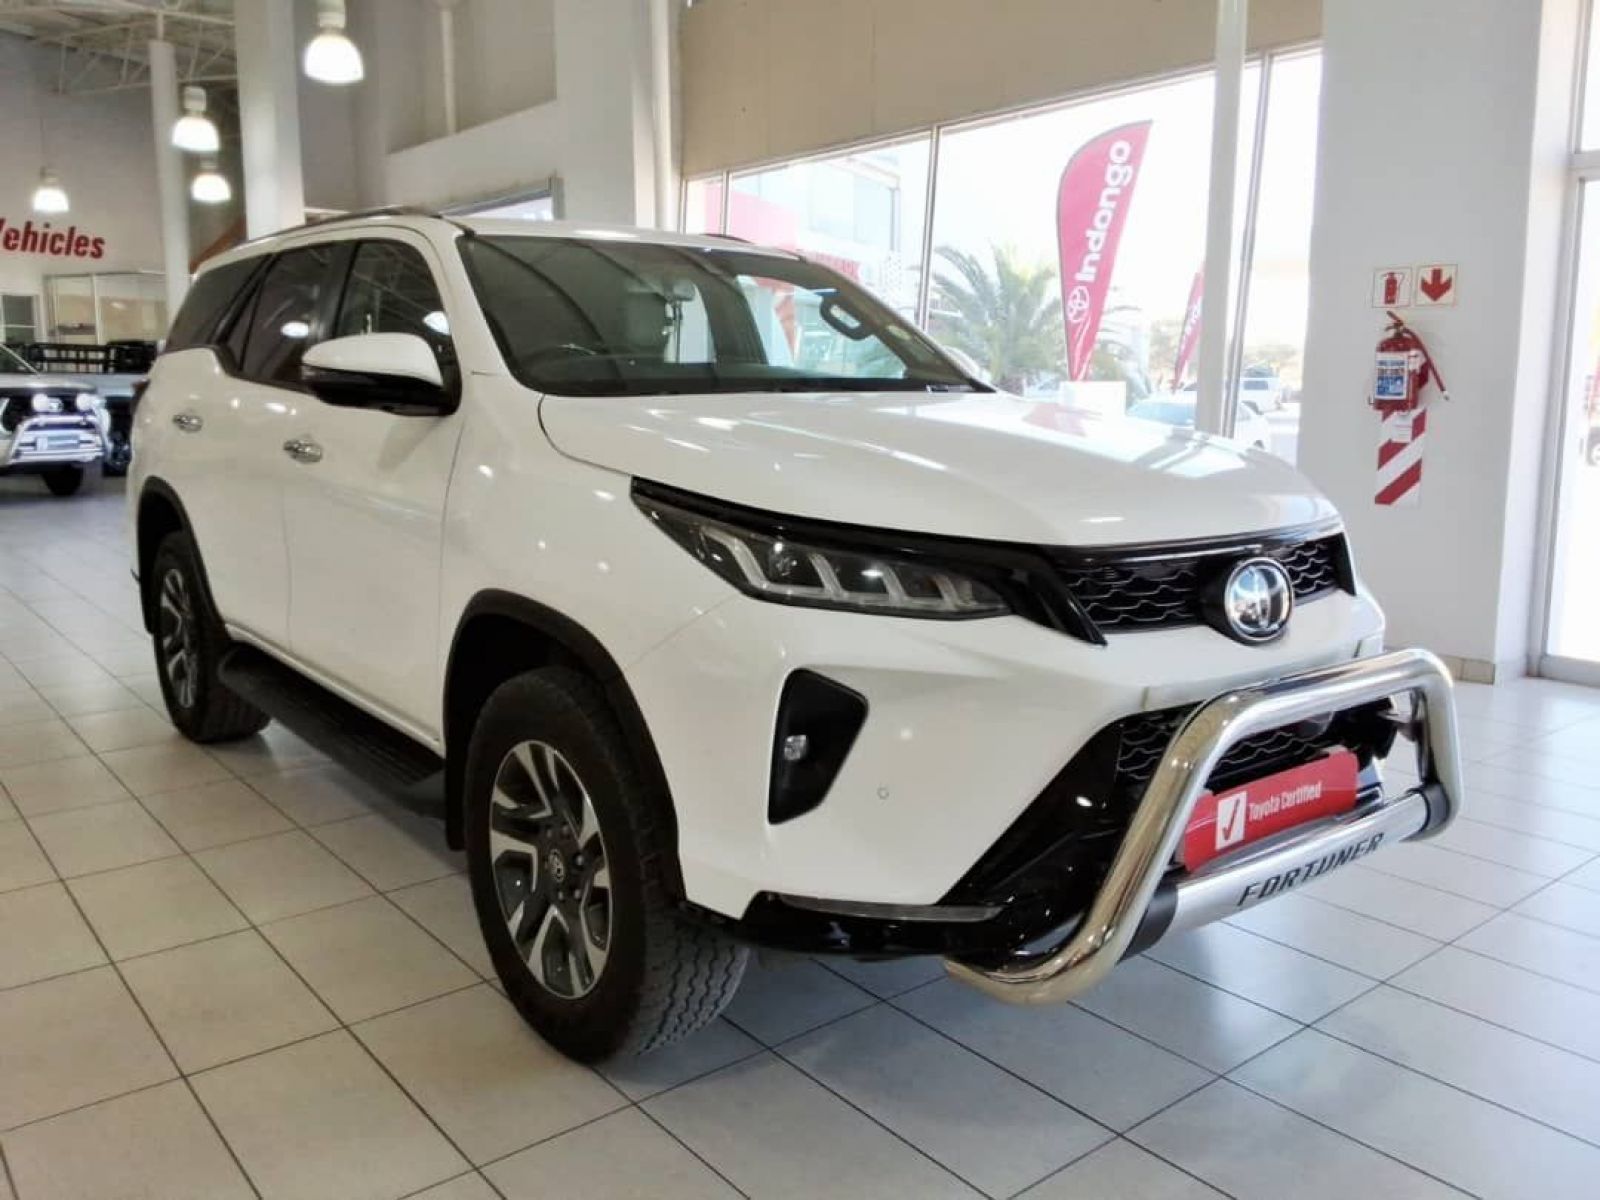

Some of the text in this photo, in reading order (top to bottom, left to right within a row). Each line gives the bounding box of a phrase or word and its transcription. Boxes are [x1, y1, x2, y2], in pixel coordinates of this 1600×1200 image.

[0, 218, 105, 259] ehicles
[1075, 140, 1133, 283] Indongo
[1248, 780, 1322, 822] Toyota Certified
[1237, 832, 1385, 907] FORTUNER
